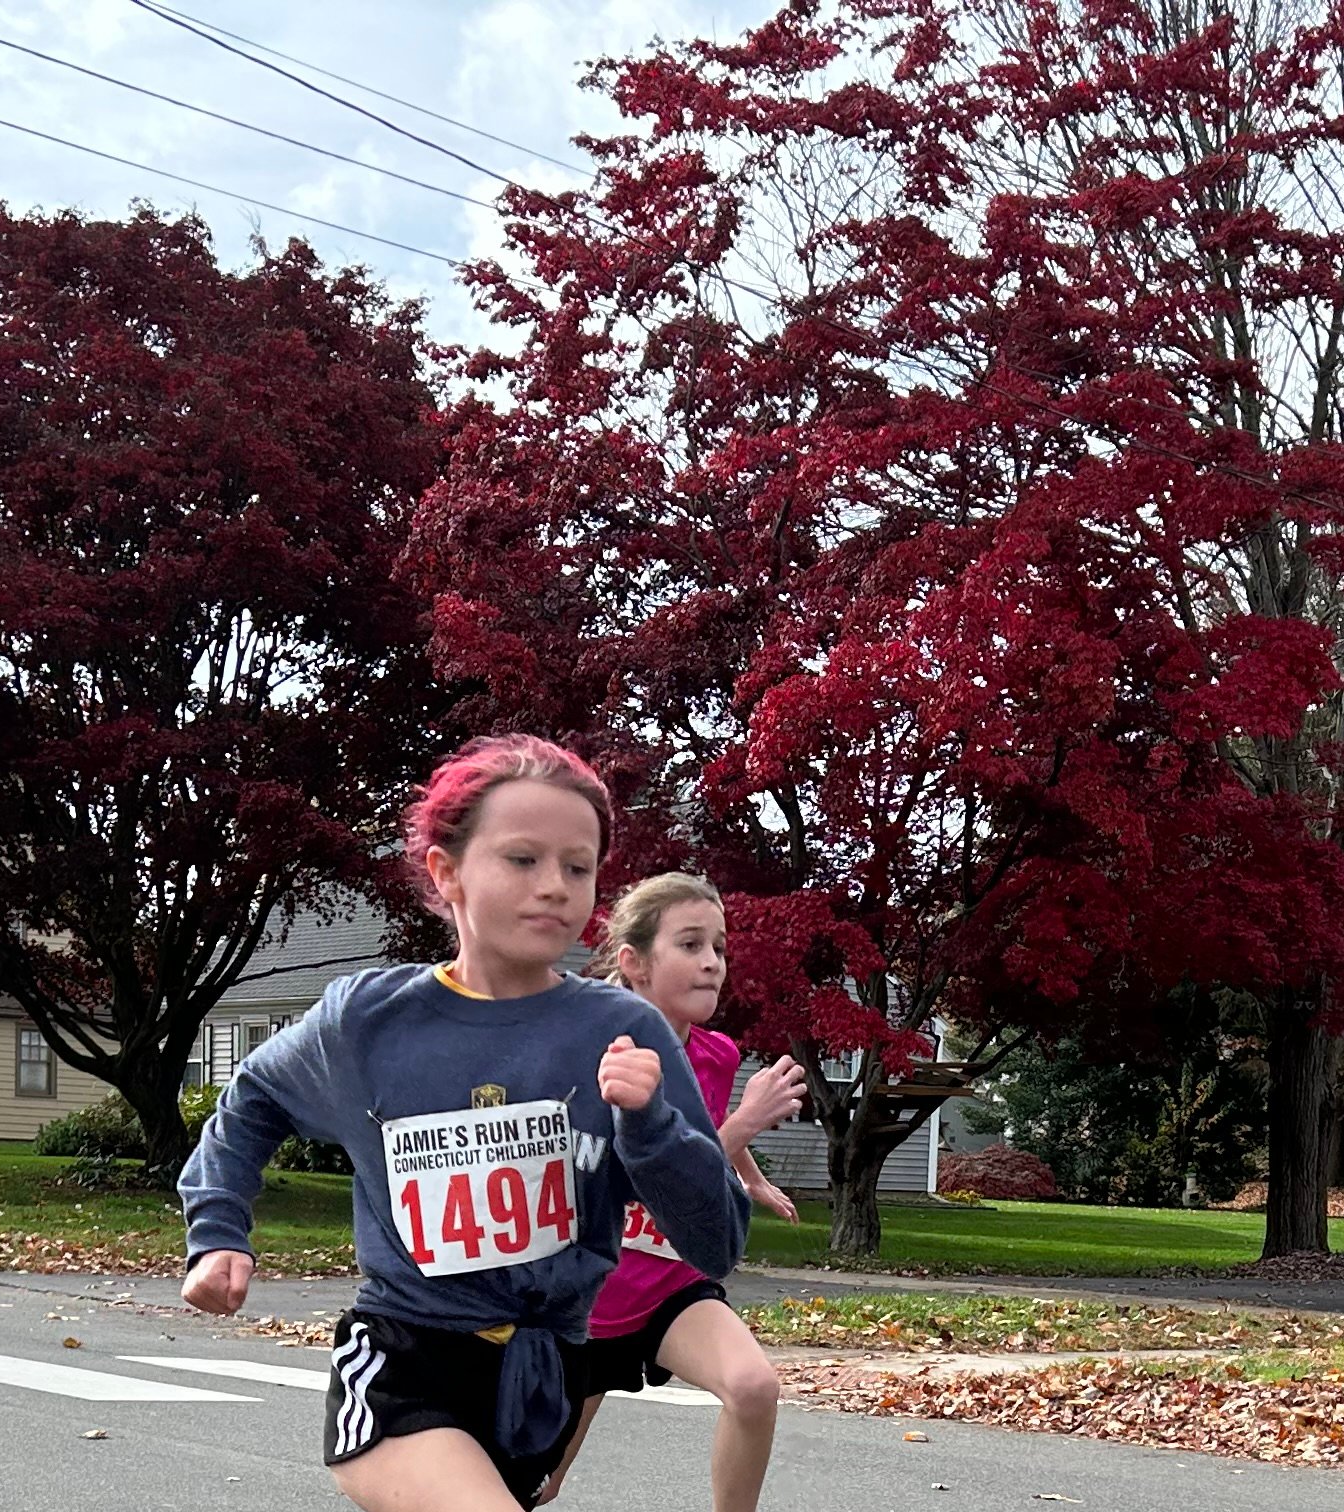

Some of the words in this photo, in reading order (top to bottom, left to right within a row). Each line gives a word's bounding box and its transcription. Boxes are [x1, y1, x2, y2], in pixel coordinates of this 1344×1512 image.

[392, 1125, 468, 1156] JAMIE'S
[475, 1119, 519, 1146] RUN
[526, 1113, 565, 1139] FOR
[394, 1149, 481, 1174] CONNECTICUT
[486, 1137, 567, 1163] CHILDREN'S
[401, 1159, 574, 1265] 1494
